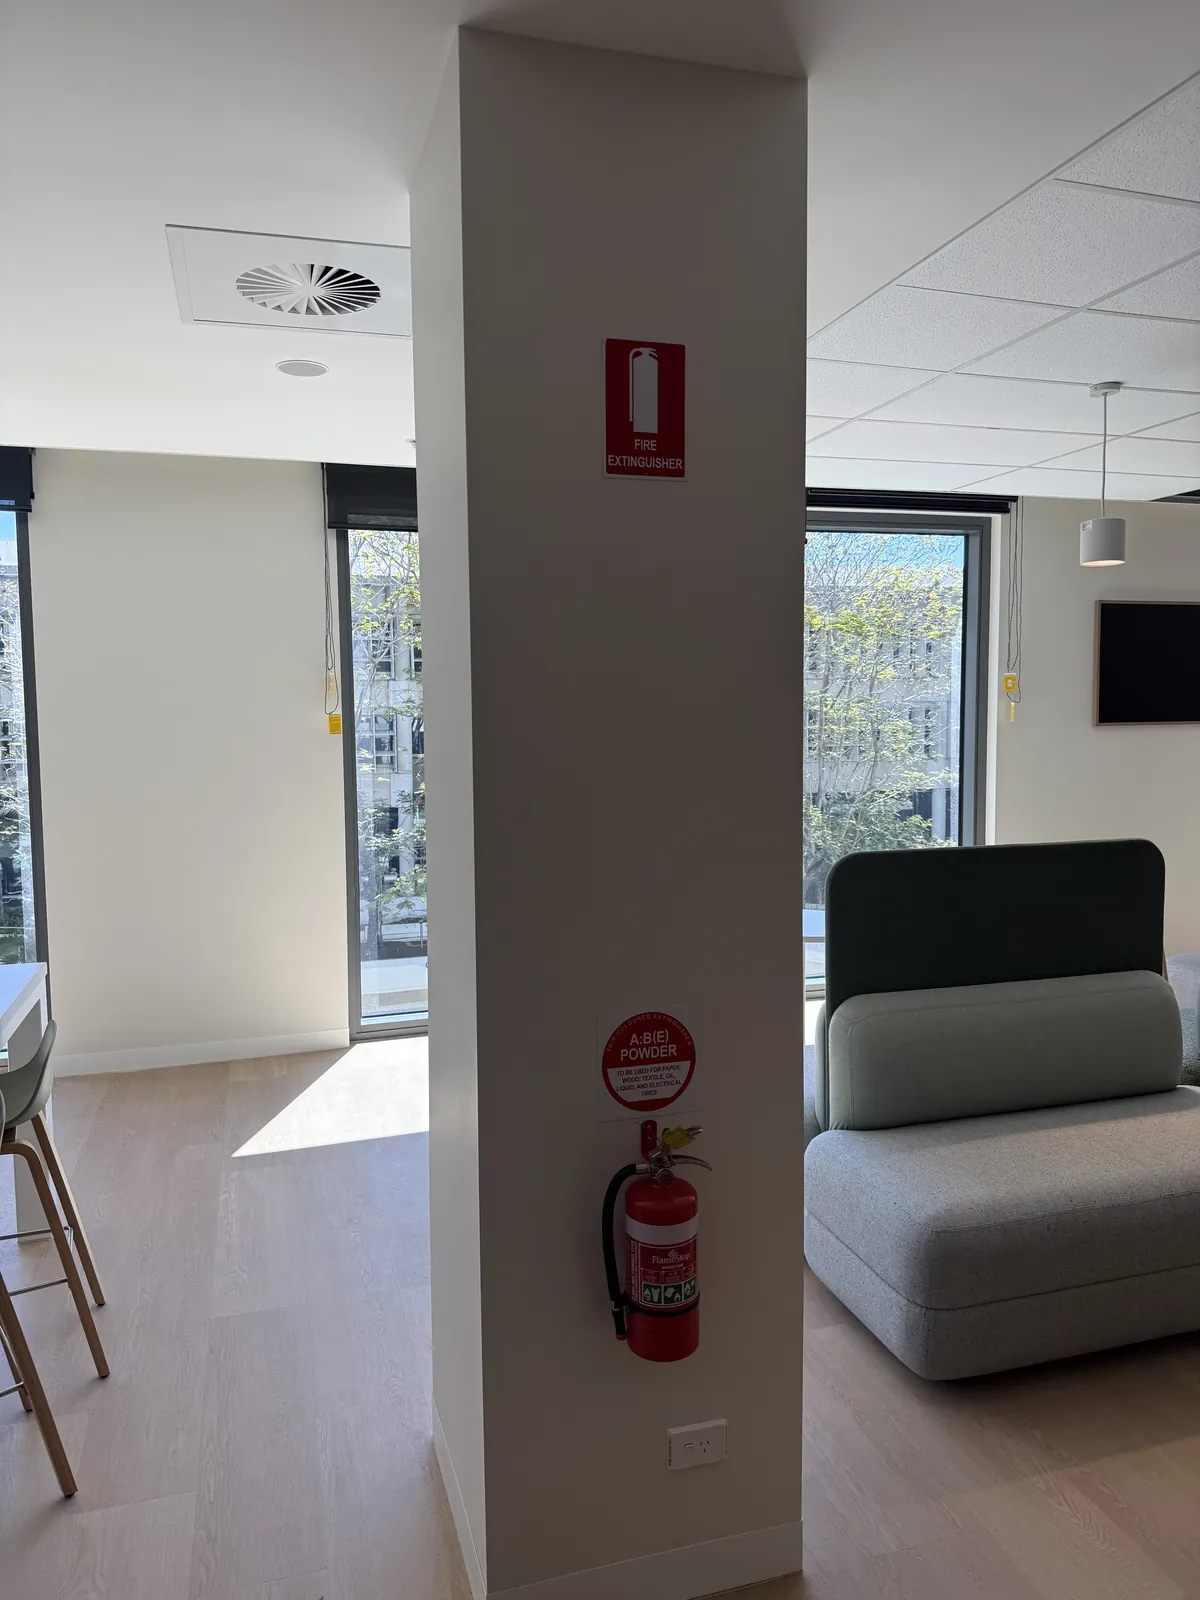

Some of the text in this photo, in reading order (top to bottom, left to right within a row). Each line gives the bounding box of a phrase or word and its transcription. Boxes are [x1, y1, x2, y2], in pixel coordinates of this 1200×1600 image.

[634, 439, 657, 451] FIRE
[607, 454, 683, 470] EXTINGUISHER
[615, 1013, 651, 1036] COLOURED
[653, 1013, 693, 1046] EXTINGUISHER
[629, 1029, 669, 1046] A:B(E)
[620, 1044, 677, 1062] POWDER
[616, 1079, 682, 1092] LIQUID, AND ELECTRICAL
[641, 1089, 657, 1097] FIRES
[652, 1252, 691, 1265] FlameStop
